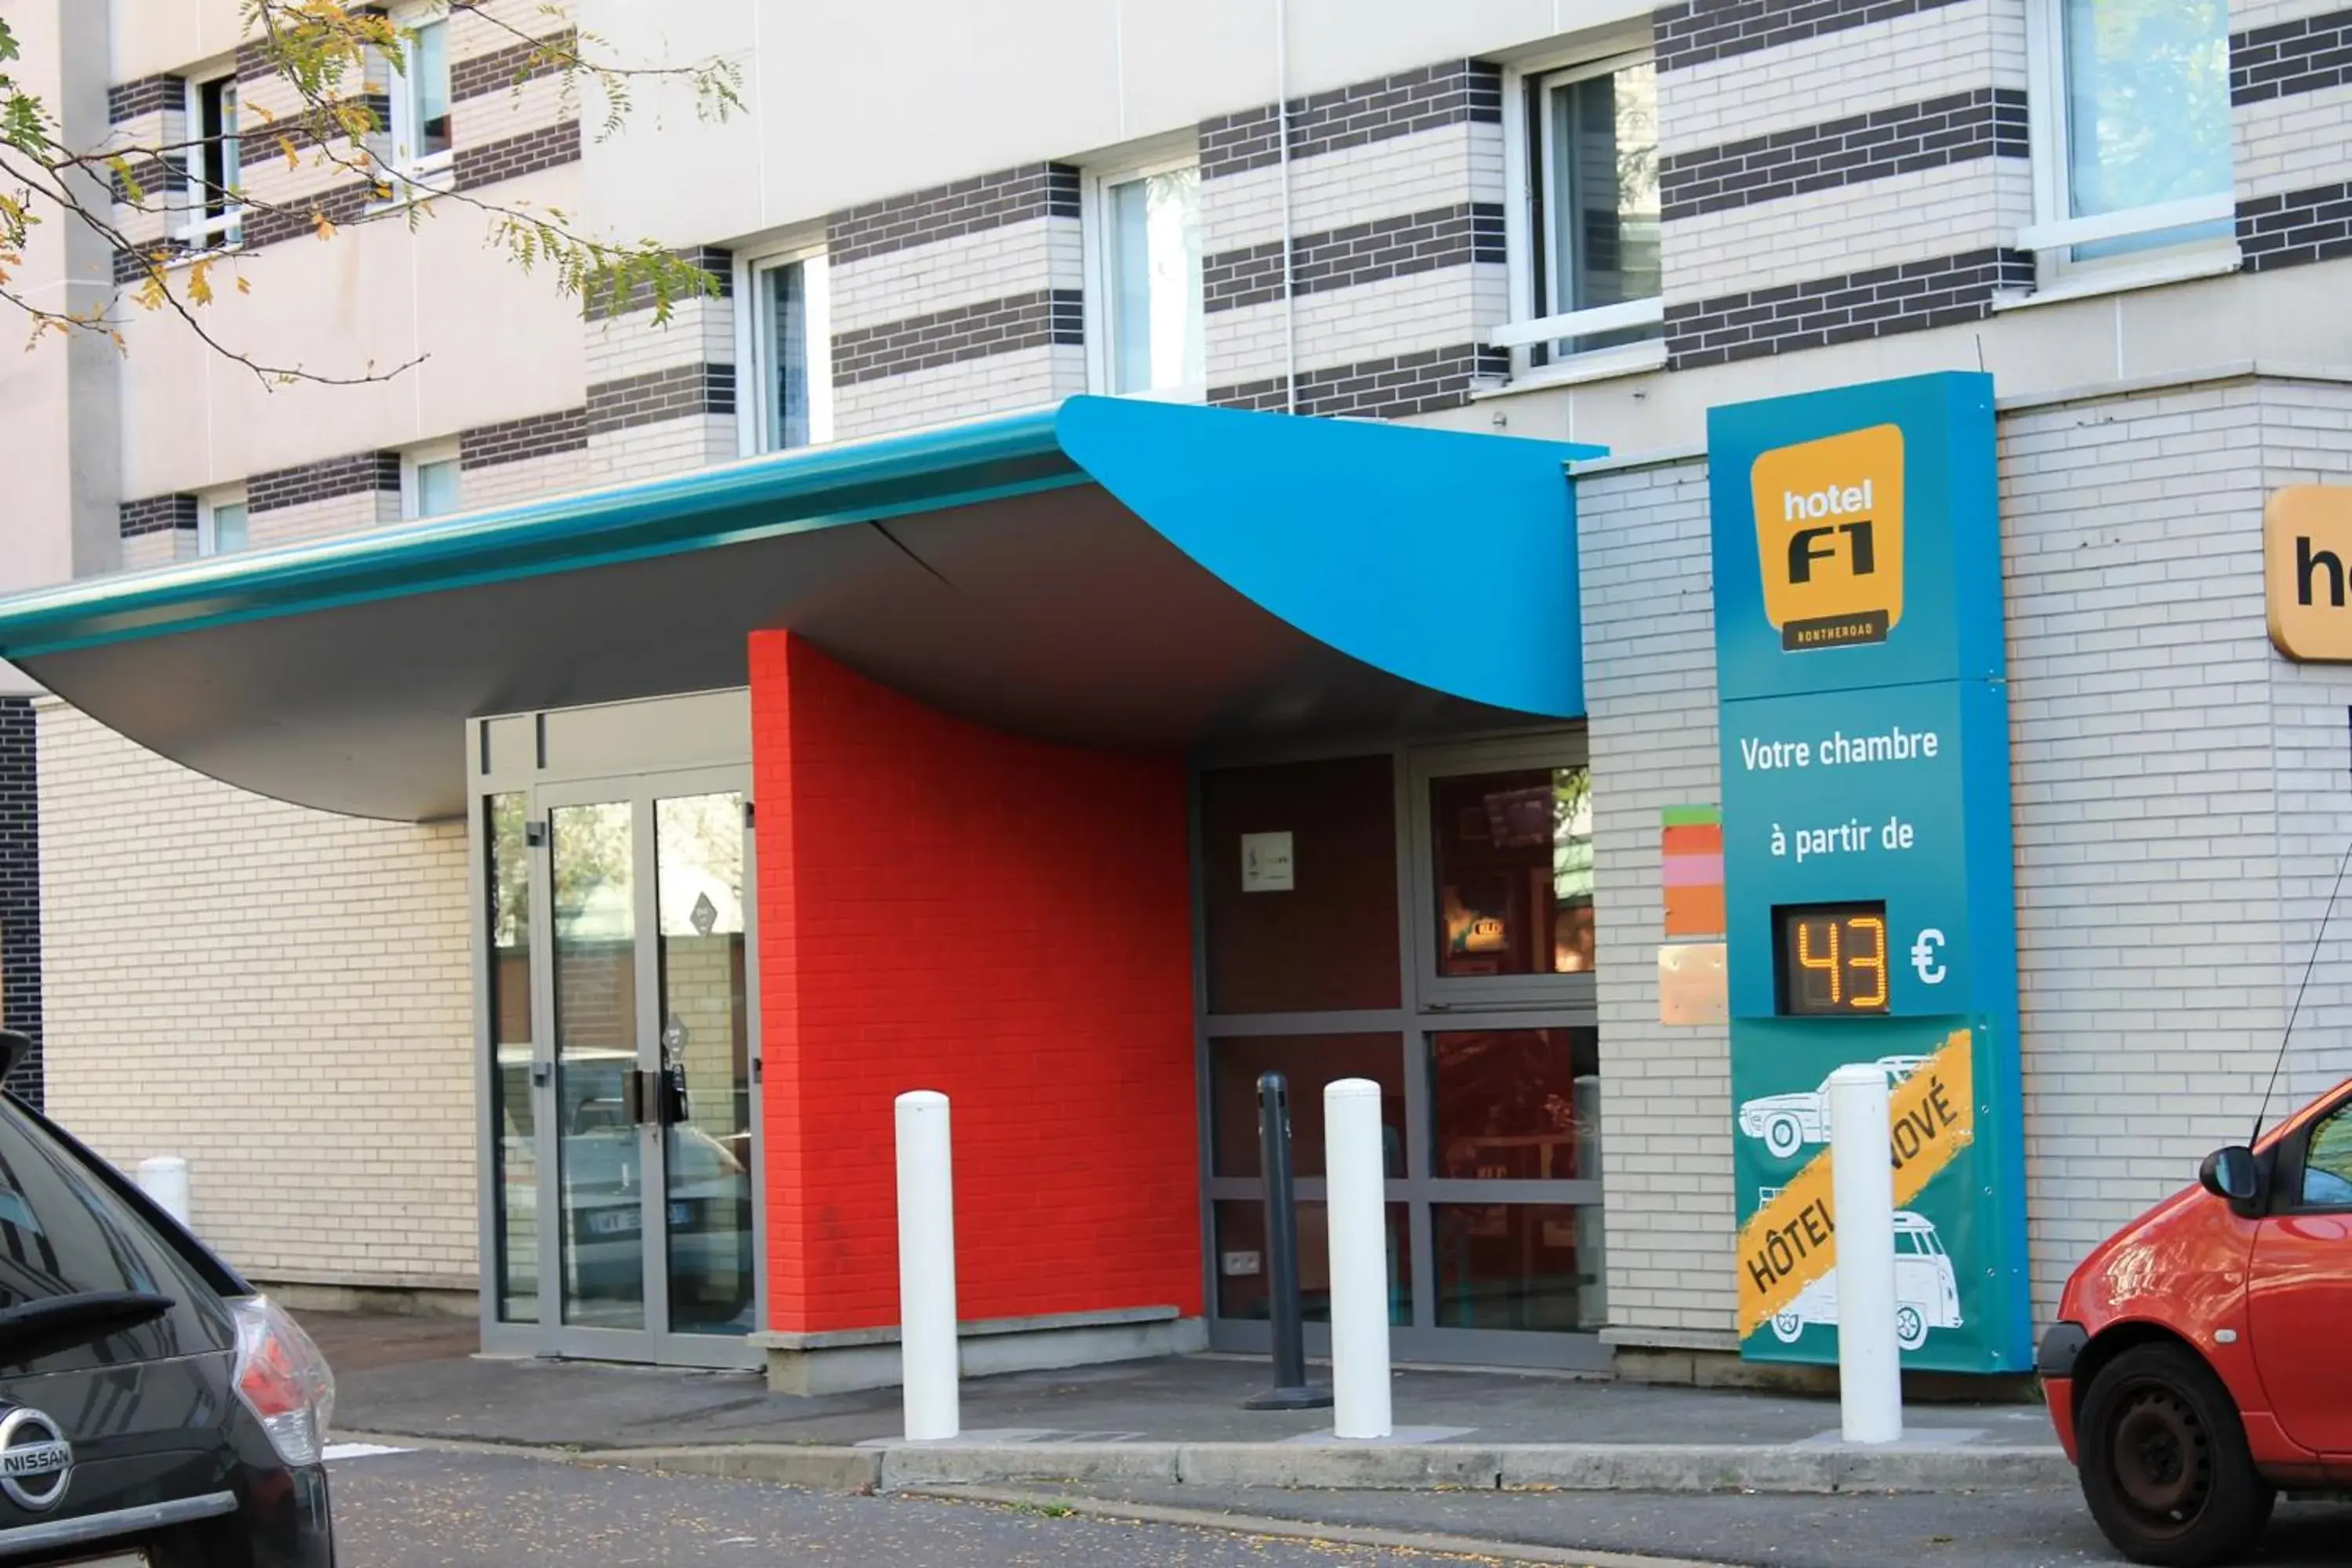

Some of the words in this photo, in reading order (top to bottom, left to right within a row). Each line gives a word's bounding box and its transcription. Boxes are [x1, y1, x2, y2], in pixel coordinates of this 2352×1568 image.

[1784, 477, 1873, 521] hotel
[1788, 519, 1875, 584] F1
[2296, 535, 2352, 606] h
[1740, 738, 1809, 770] Votre
[1820, 726, 1938, 764] chambre
[1771, 823, 1786, 855] à
[1796, 818, 1872, 863] partir
[1882, 816, 1914, 849] de
[1798, 917, 1886, 1006] 43
[1911, 927, 1947, 984] €
[4, 1450, 69, 1472] NISSAN
